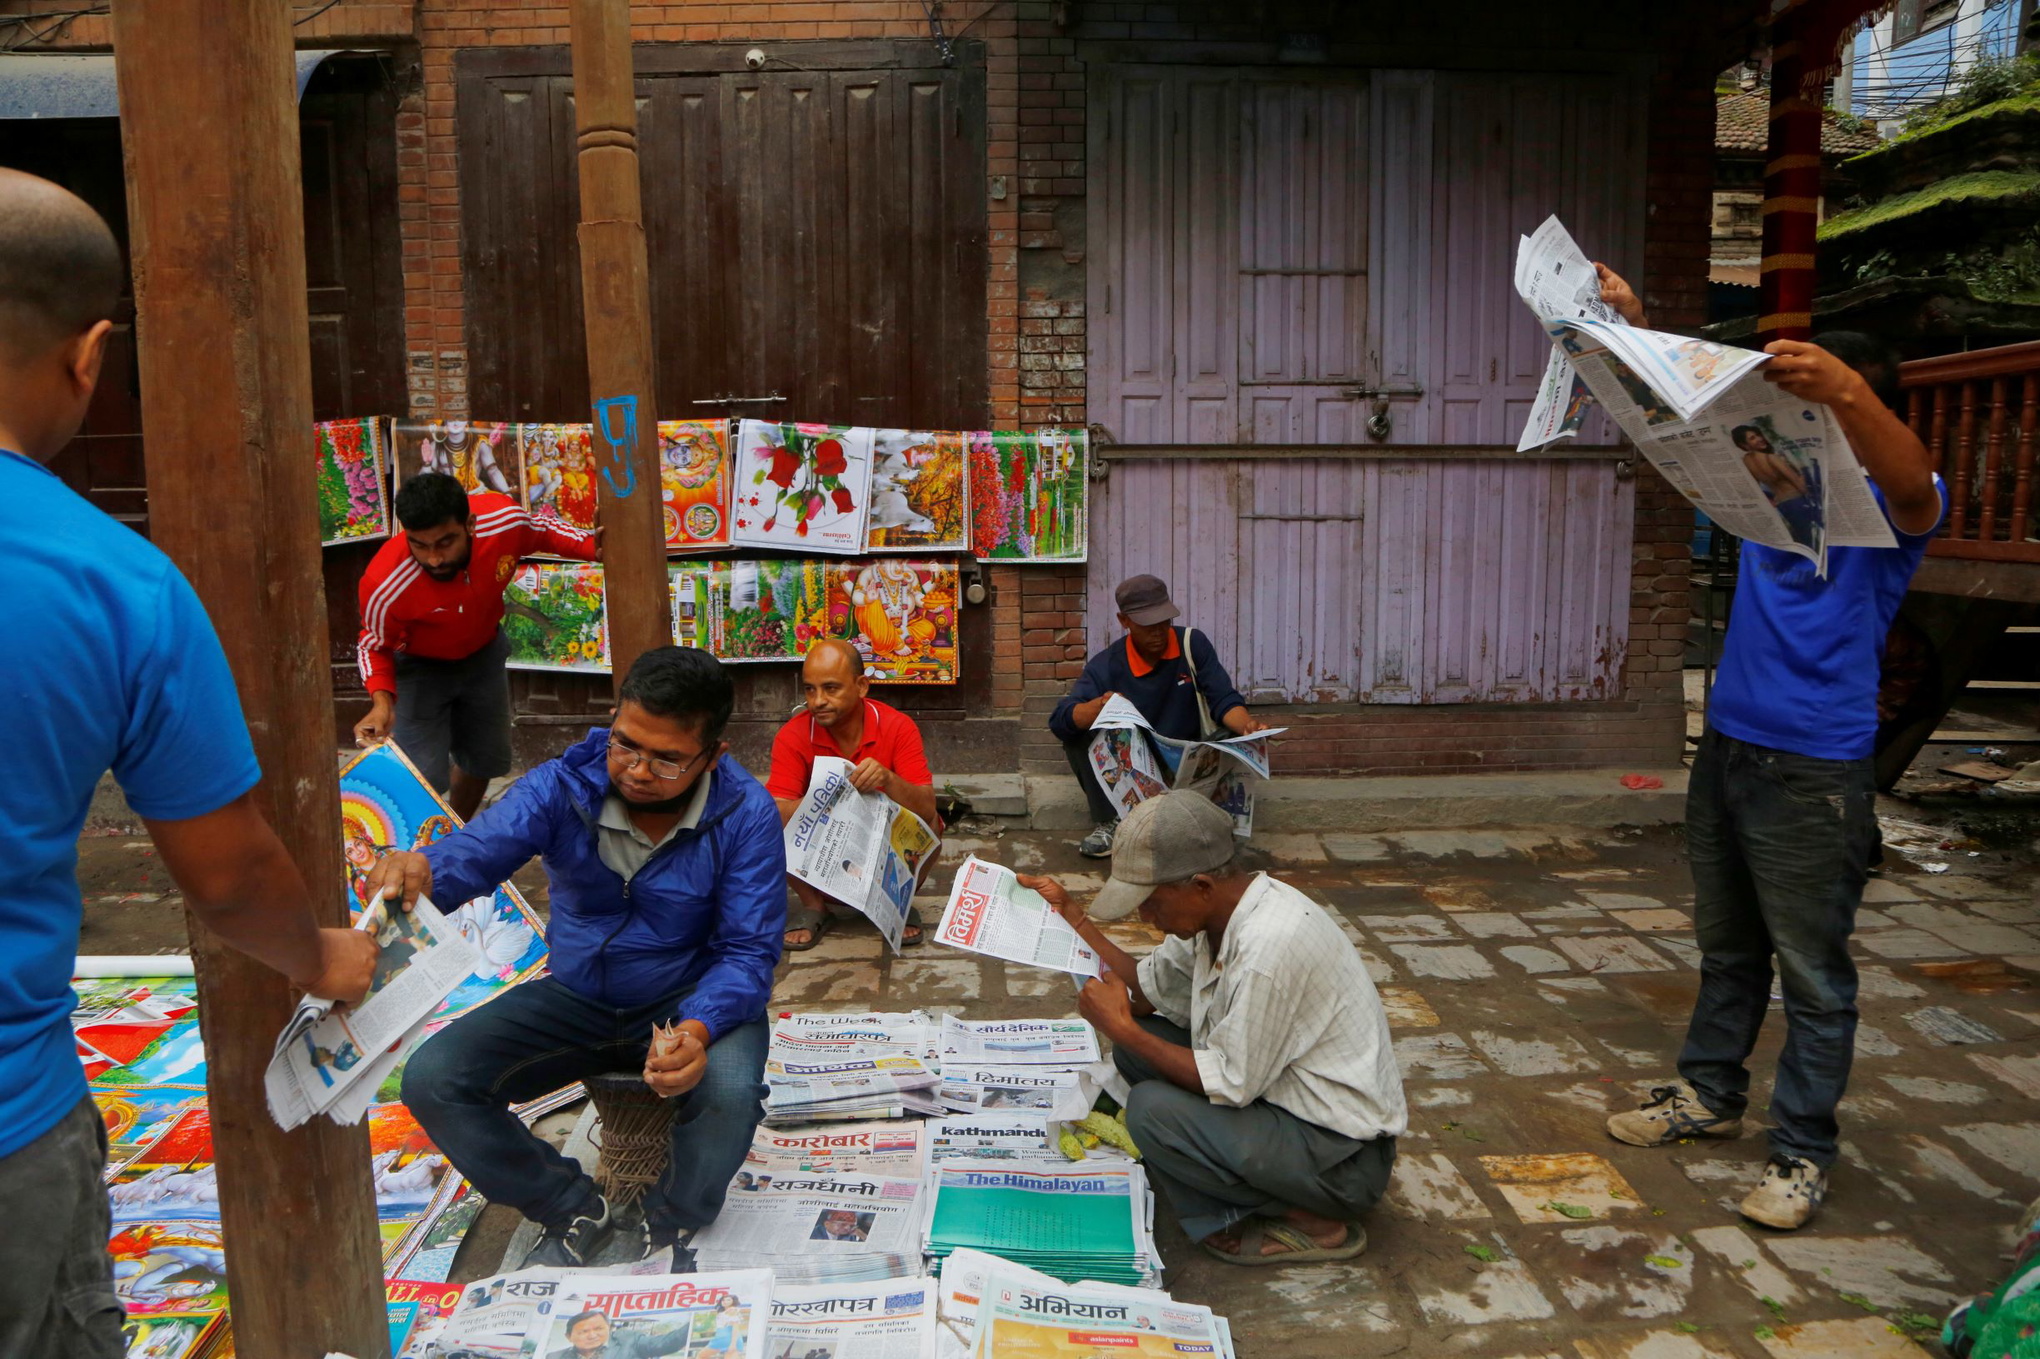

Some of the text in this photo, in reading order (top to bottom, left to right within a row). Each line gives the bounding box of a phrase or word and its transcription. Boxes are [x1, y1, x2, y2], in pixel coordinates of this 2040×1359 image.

[794, 771, 840, 849] नयाँ पत्रिका
[946, 888, 984, 944] विमर्श
[795, 1017, 882, 1025] The Week
[1008, 1023, 1049, 1032] दैनिक
[974, 1071, 1057, 1087] हिमालय
[772, 1132, 872, 1148] कारोबार
[772, 1181, 879, 1196] राजधानी
[966, 1173, 1105, 1193] The Himalayan
[422, 1295, 436, 1304] in
[582, 1282, 731, 1318] साप्ताहिक
[1019, 1294, 1129, 1320] अभियान
[1089, 1336, 1134, 1345] asianpaints
[1177, 1344, 1212, 1352] TODAY
